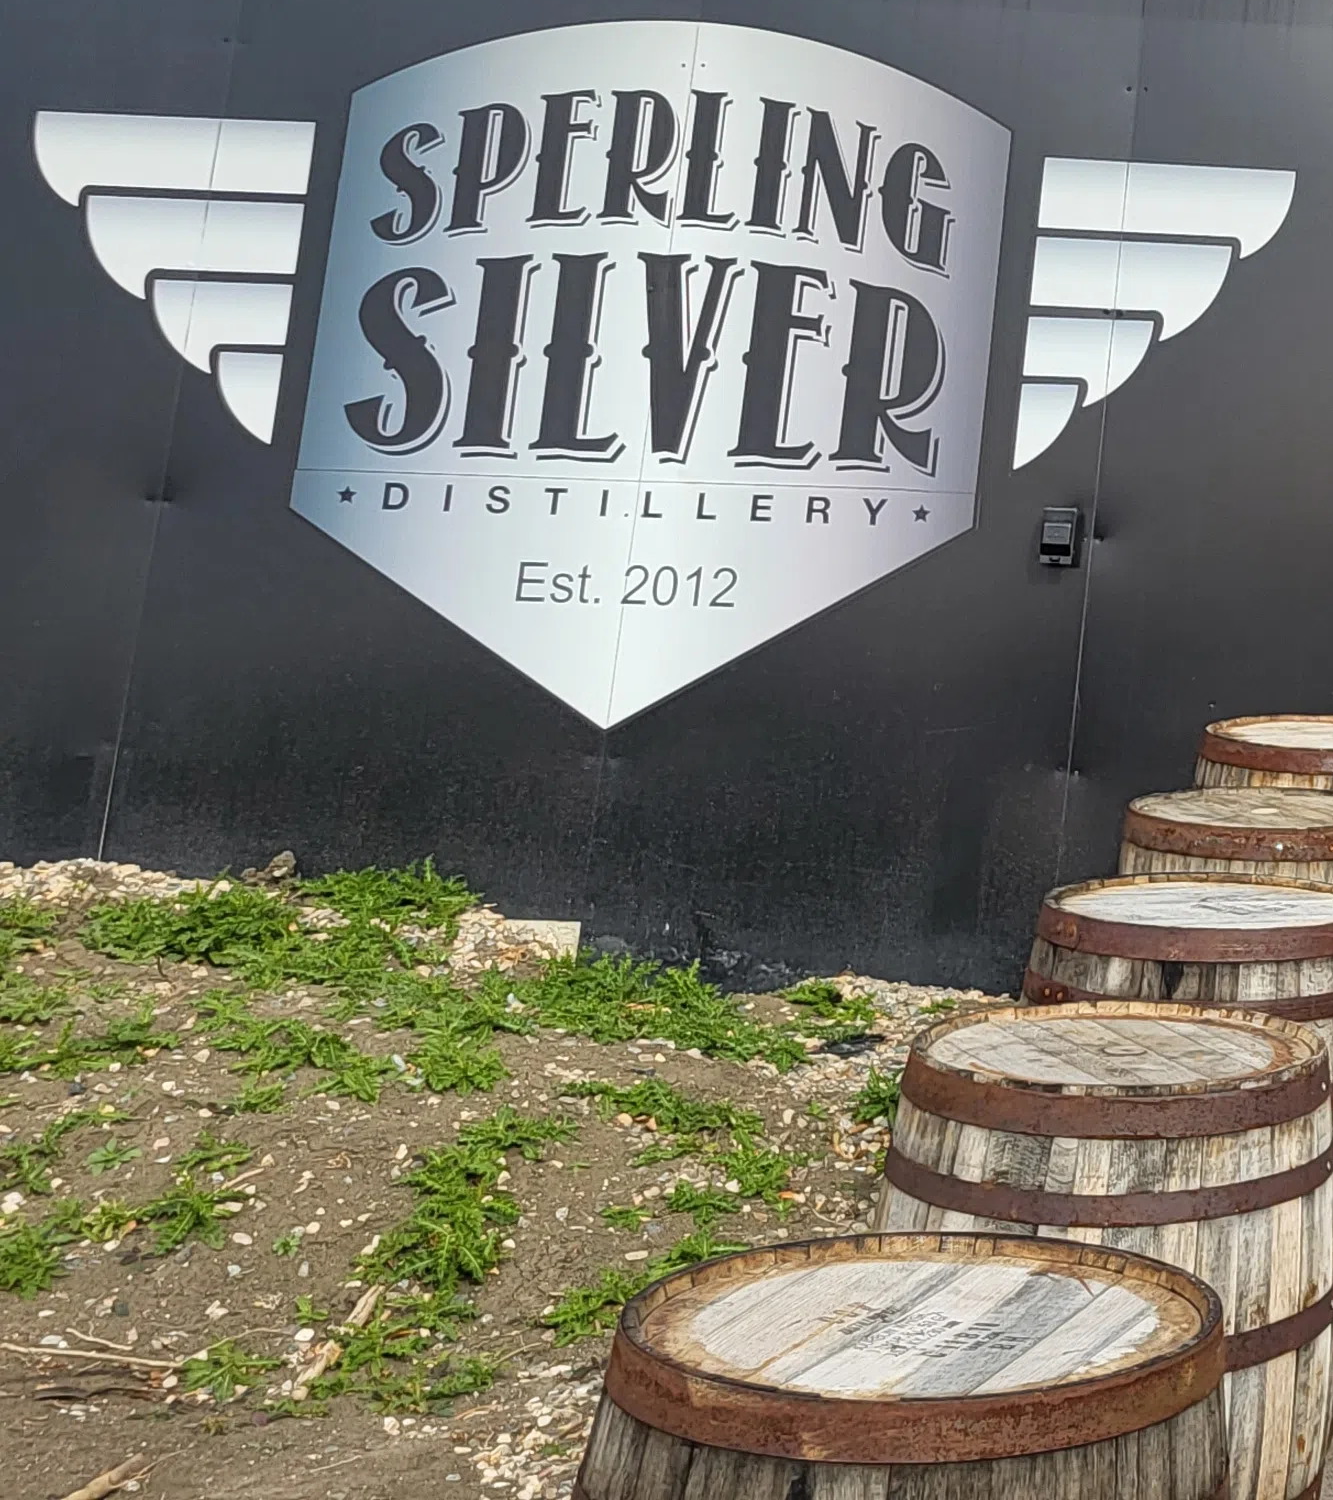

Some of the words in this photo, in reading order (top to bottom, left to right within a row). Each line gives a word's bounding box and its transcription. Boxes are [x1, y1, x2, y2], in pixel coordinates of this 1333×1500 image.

[370, 89, 954, 279] SPERLING
[344, 251, 946, 477] SILVER
[381, 482, 888, 525] DISTILLERY
[515, 561, 601, 604] Est.
[622, 565, 739, 608] 2012
